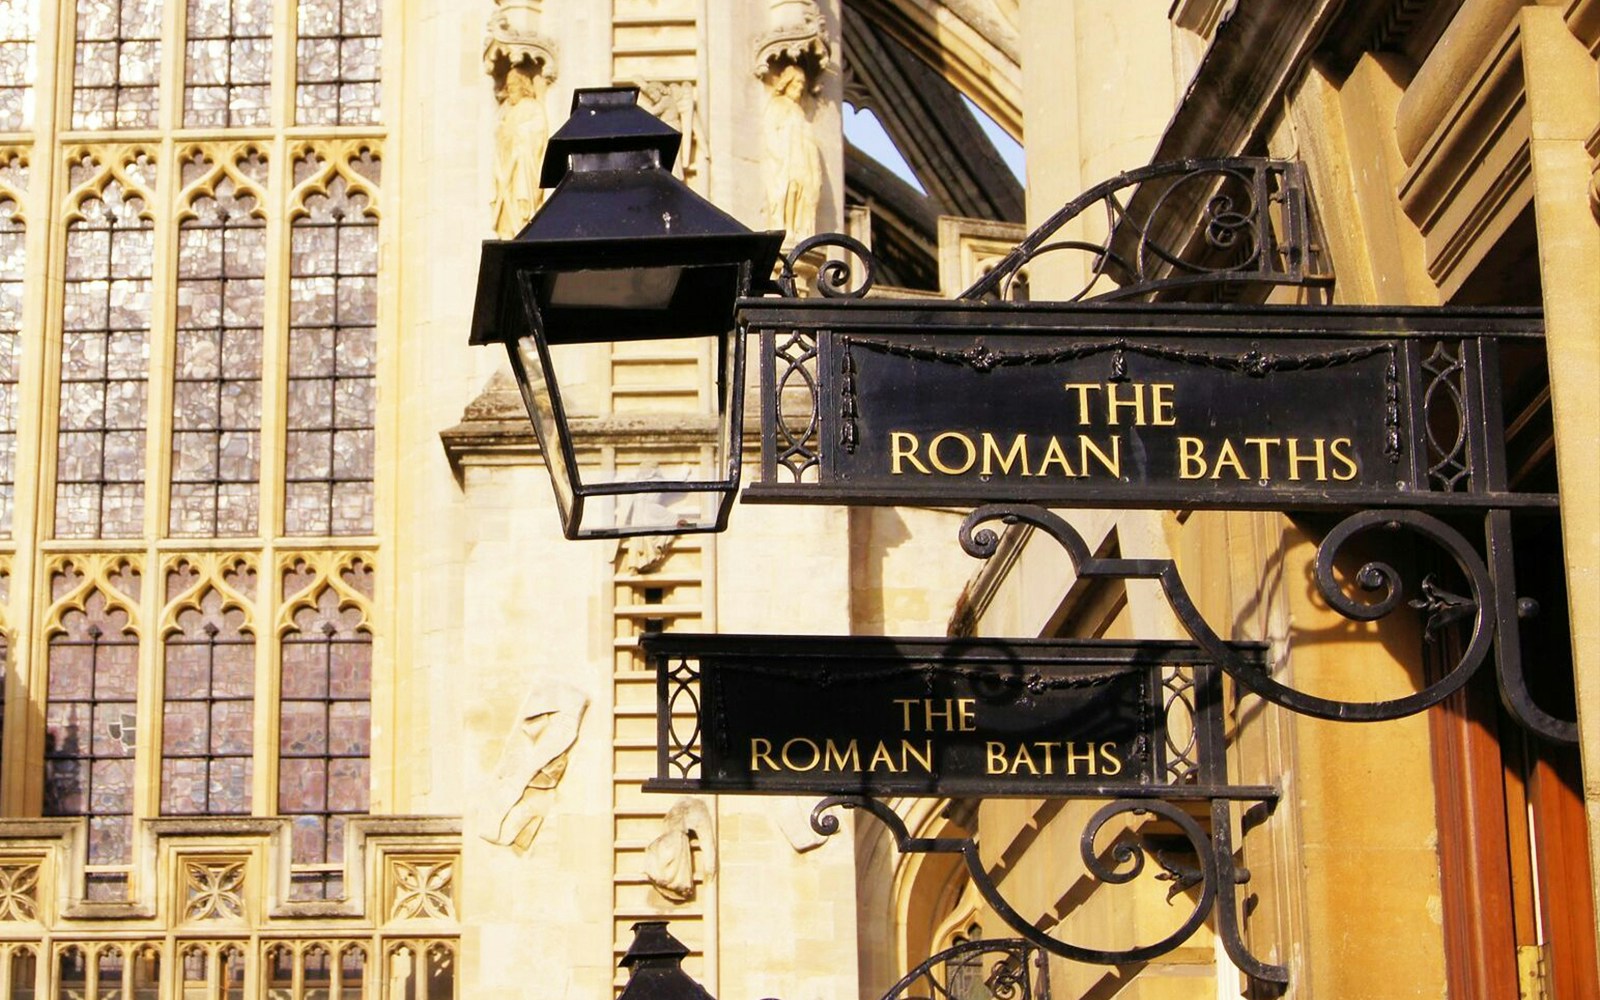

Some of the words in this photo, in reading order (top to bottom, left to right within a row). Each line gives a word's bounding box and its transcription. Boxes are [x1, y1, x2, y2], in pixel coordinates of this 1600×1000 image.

[1064, 382, 1177, 426] THE
[890, 431, 1121, 479] ROMAN
[1177, 436, 1358, 481] BATHS
[893, 698, 976, 732] THE
[750, 738, 933, 773] ROMAN
[985, 741, 1122, 776] BATHS
